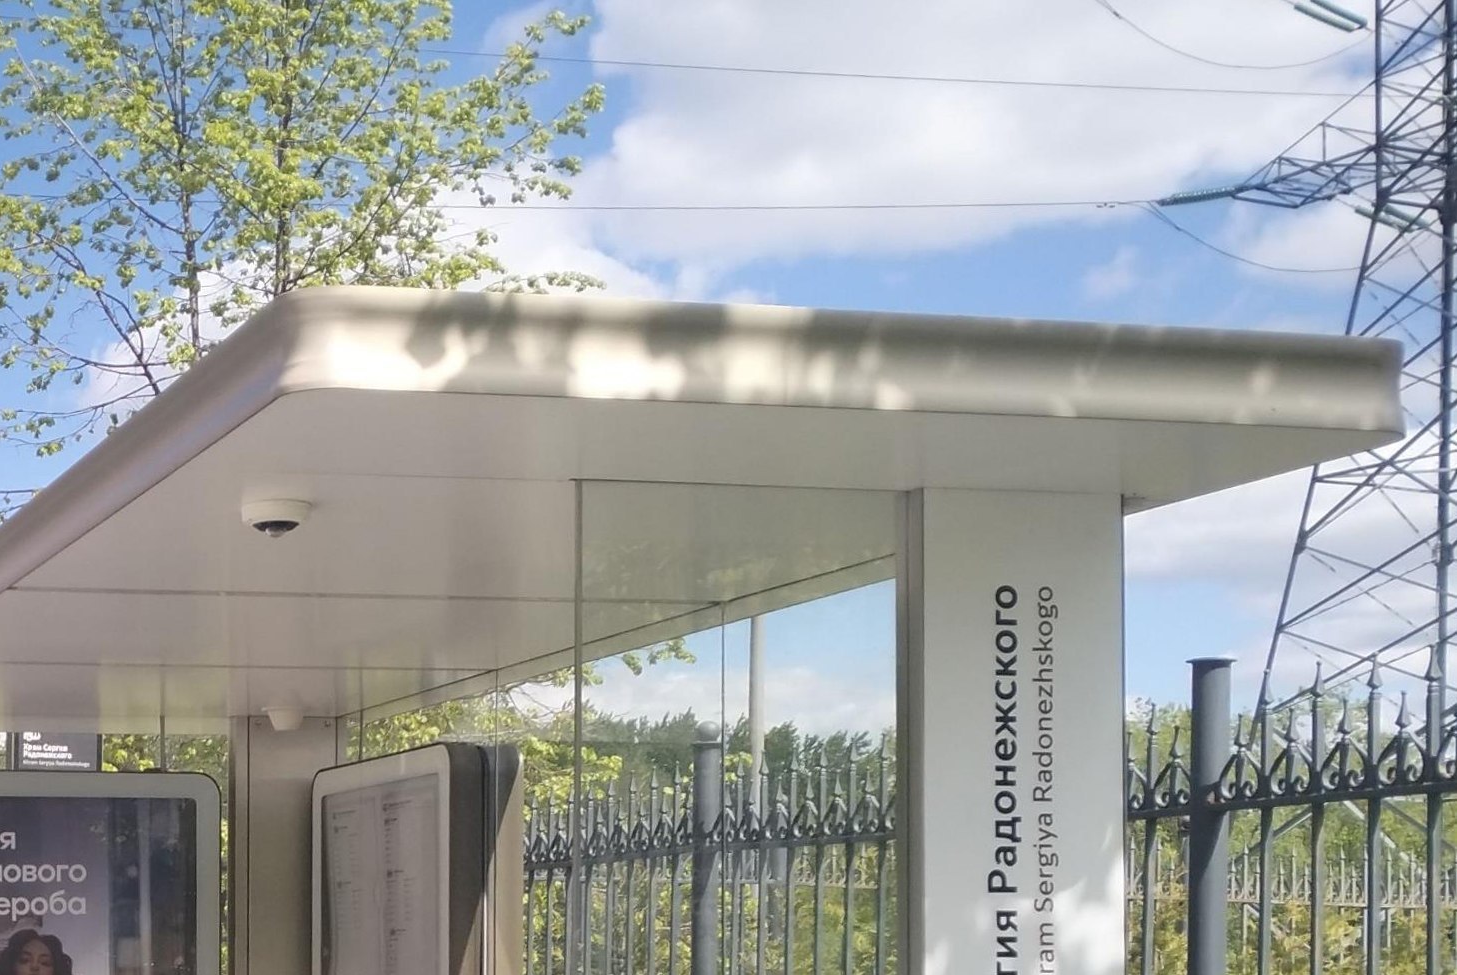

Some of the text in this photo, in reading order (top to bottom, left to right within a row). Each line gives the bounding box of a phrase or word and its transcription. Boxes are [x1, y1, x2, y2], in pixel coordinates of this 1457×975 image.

[987, 584, 1022, 893] Радонежского
[1031, 585, 1059, 802] Radonezhskogo
[1033, 812, 1059, 913] Sergiya
